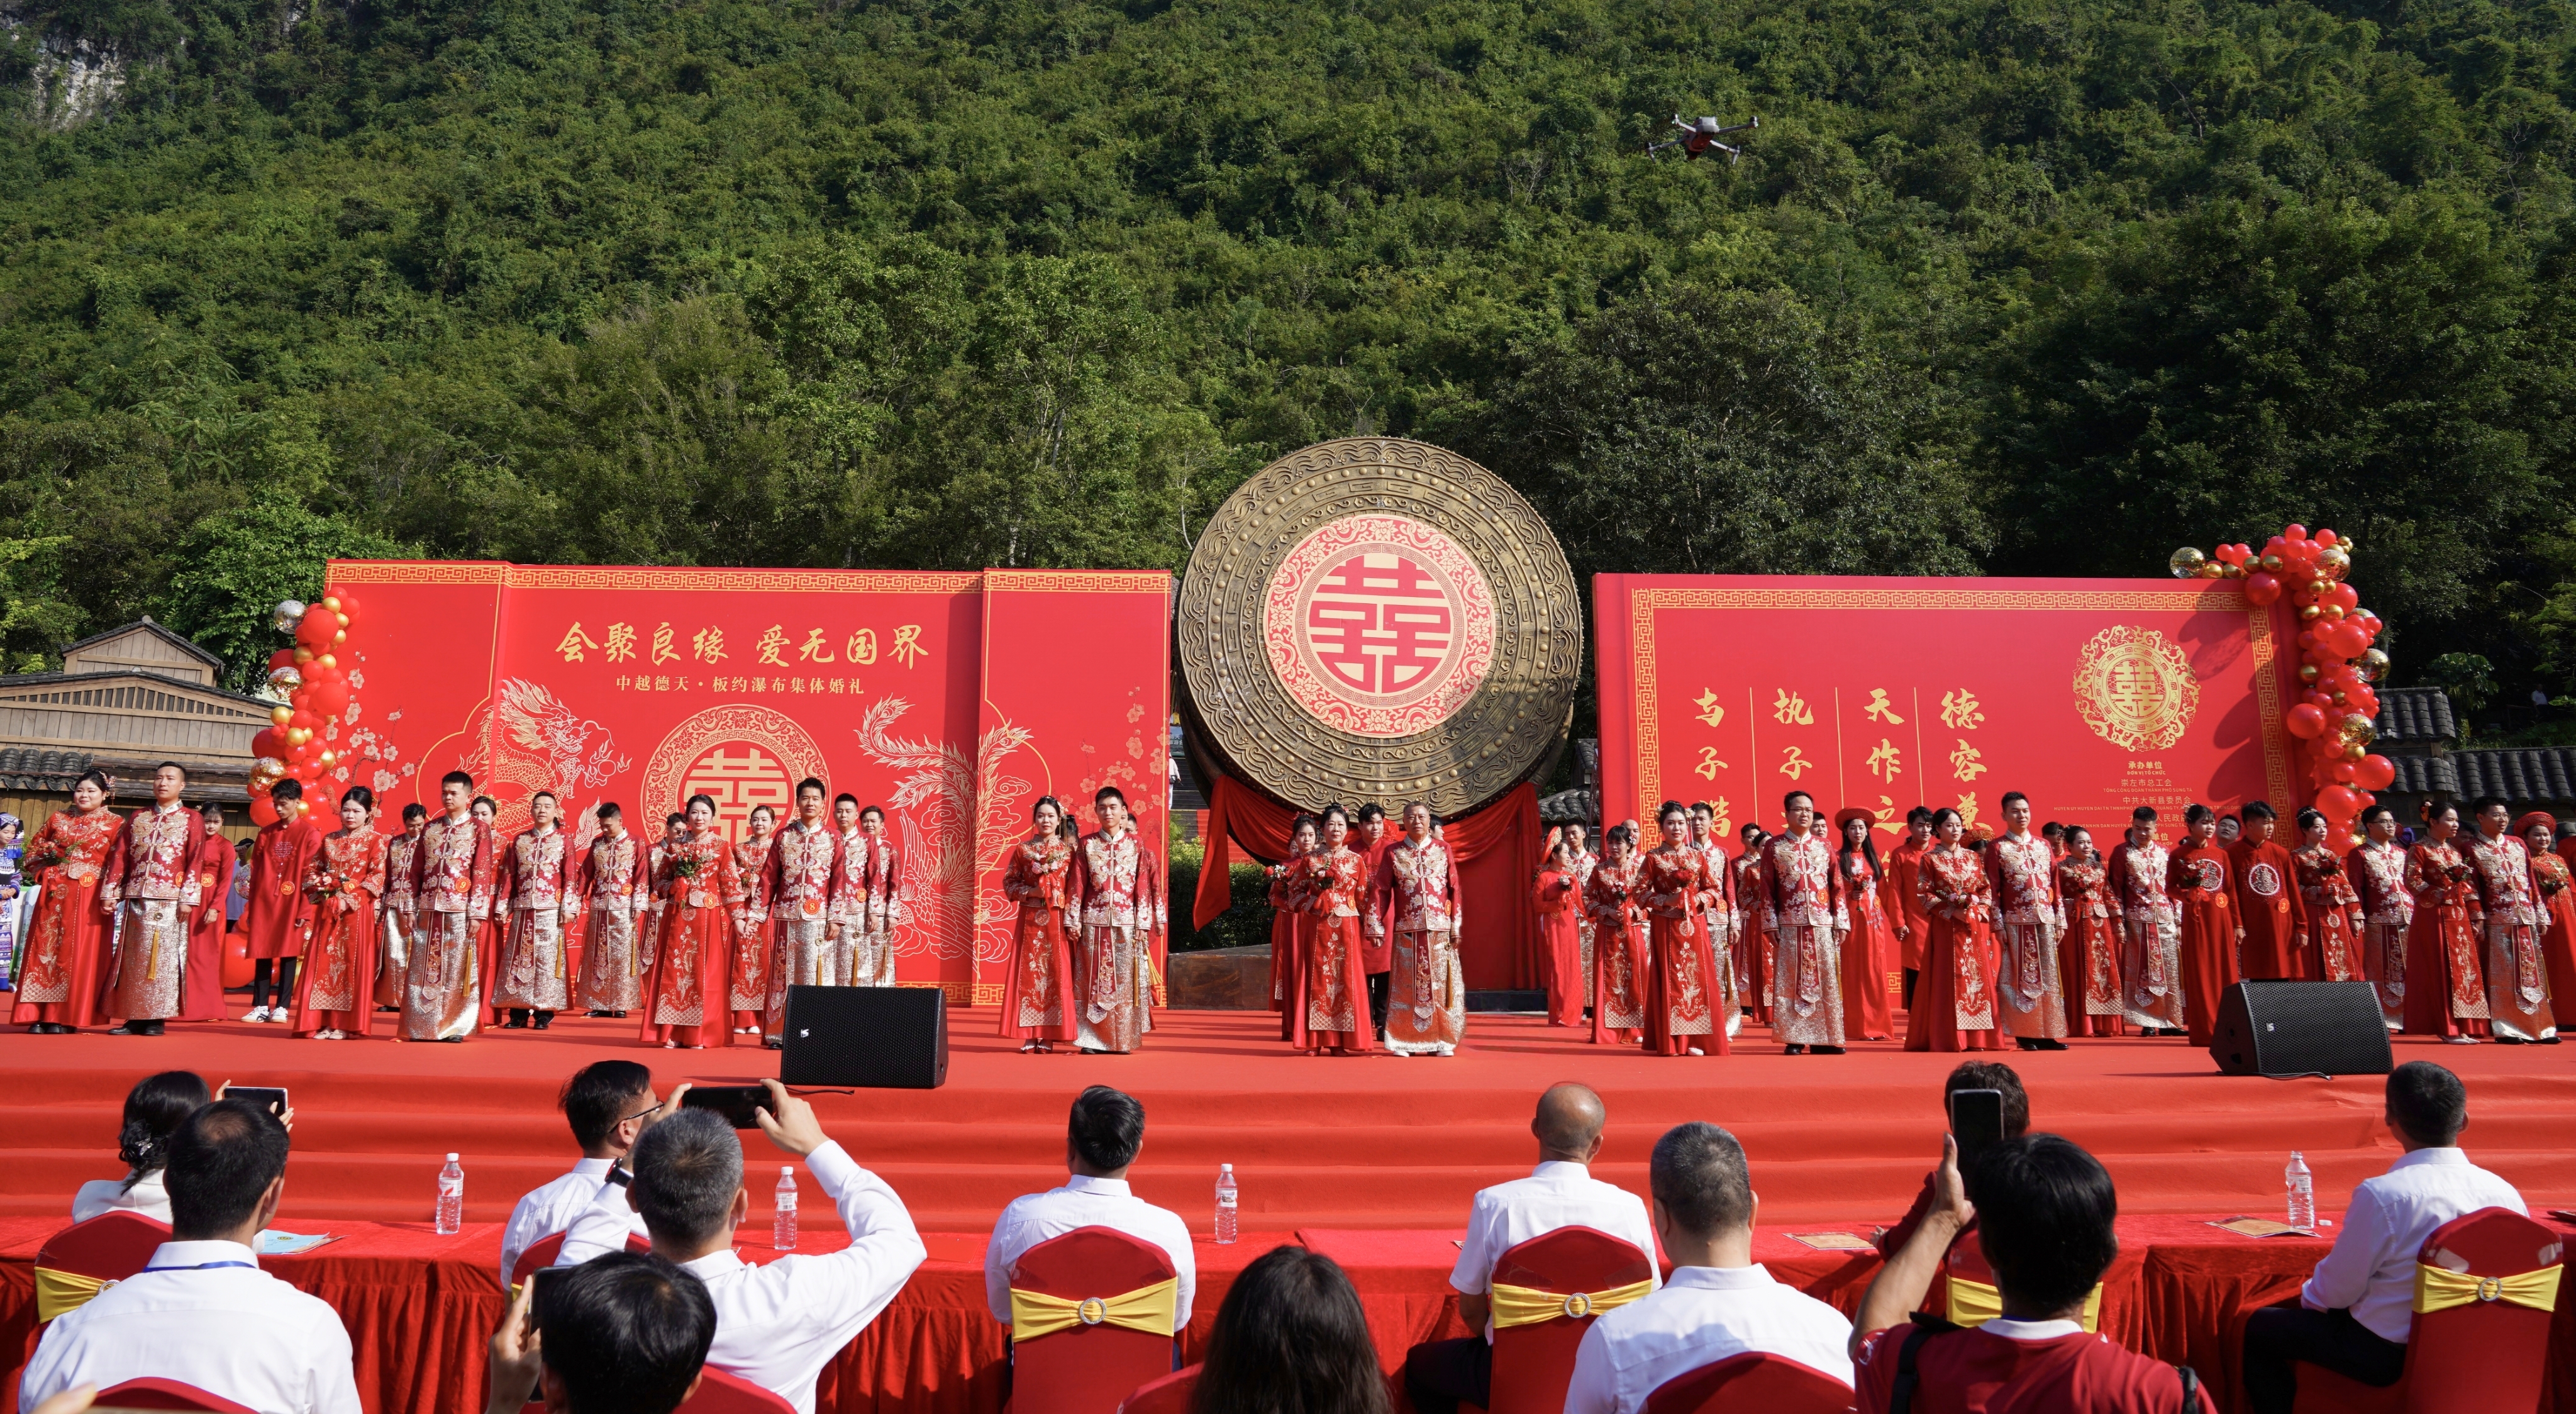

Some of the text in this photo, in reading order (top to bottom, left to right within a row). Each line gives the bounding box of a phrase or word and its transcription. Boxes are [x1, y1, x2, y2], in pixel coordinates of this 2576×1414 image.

[556, 621, 929, 669] 会聚良缘 爱无国界
[1773, 688, 1814, 828] 执子
[2128, 761, 2162, 769] 承办单位
[2121, 779, 2172, 787] 崇左市总工会
[2123, 796, 2191, 804] 中共大新县委员会
